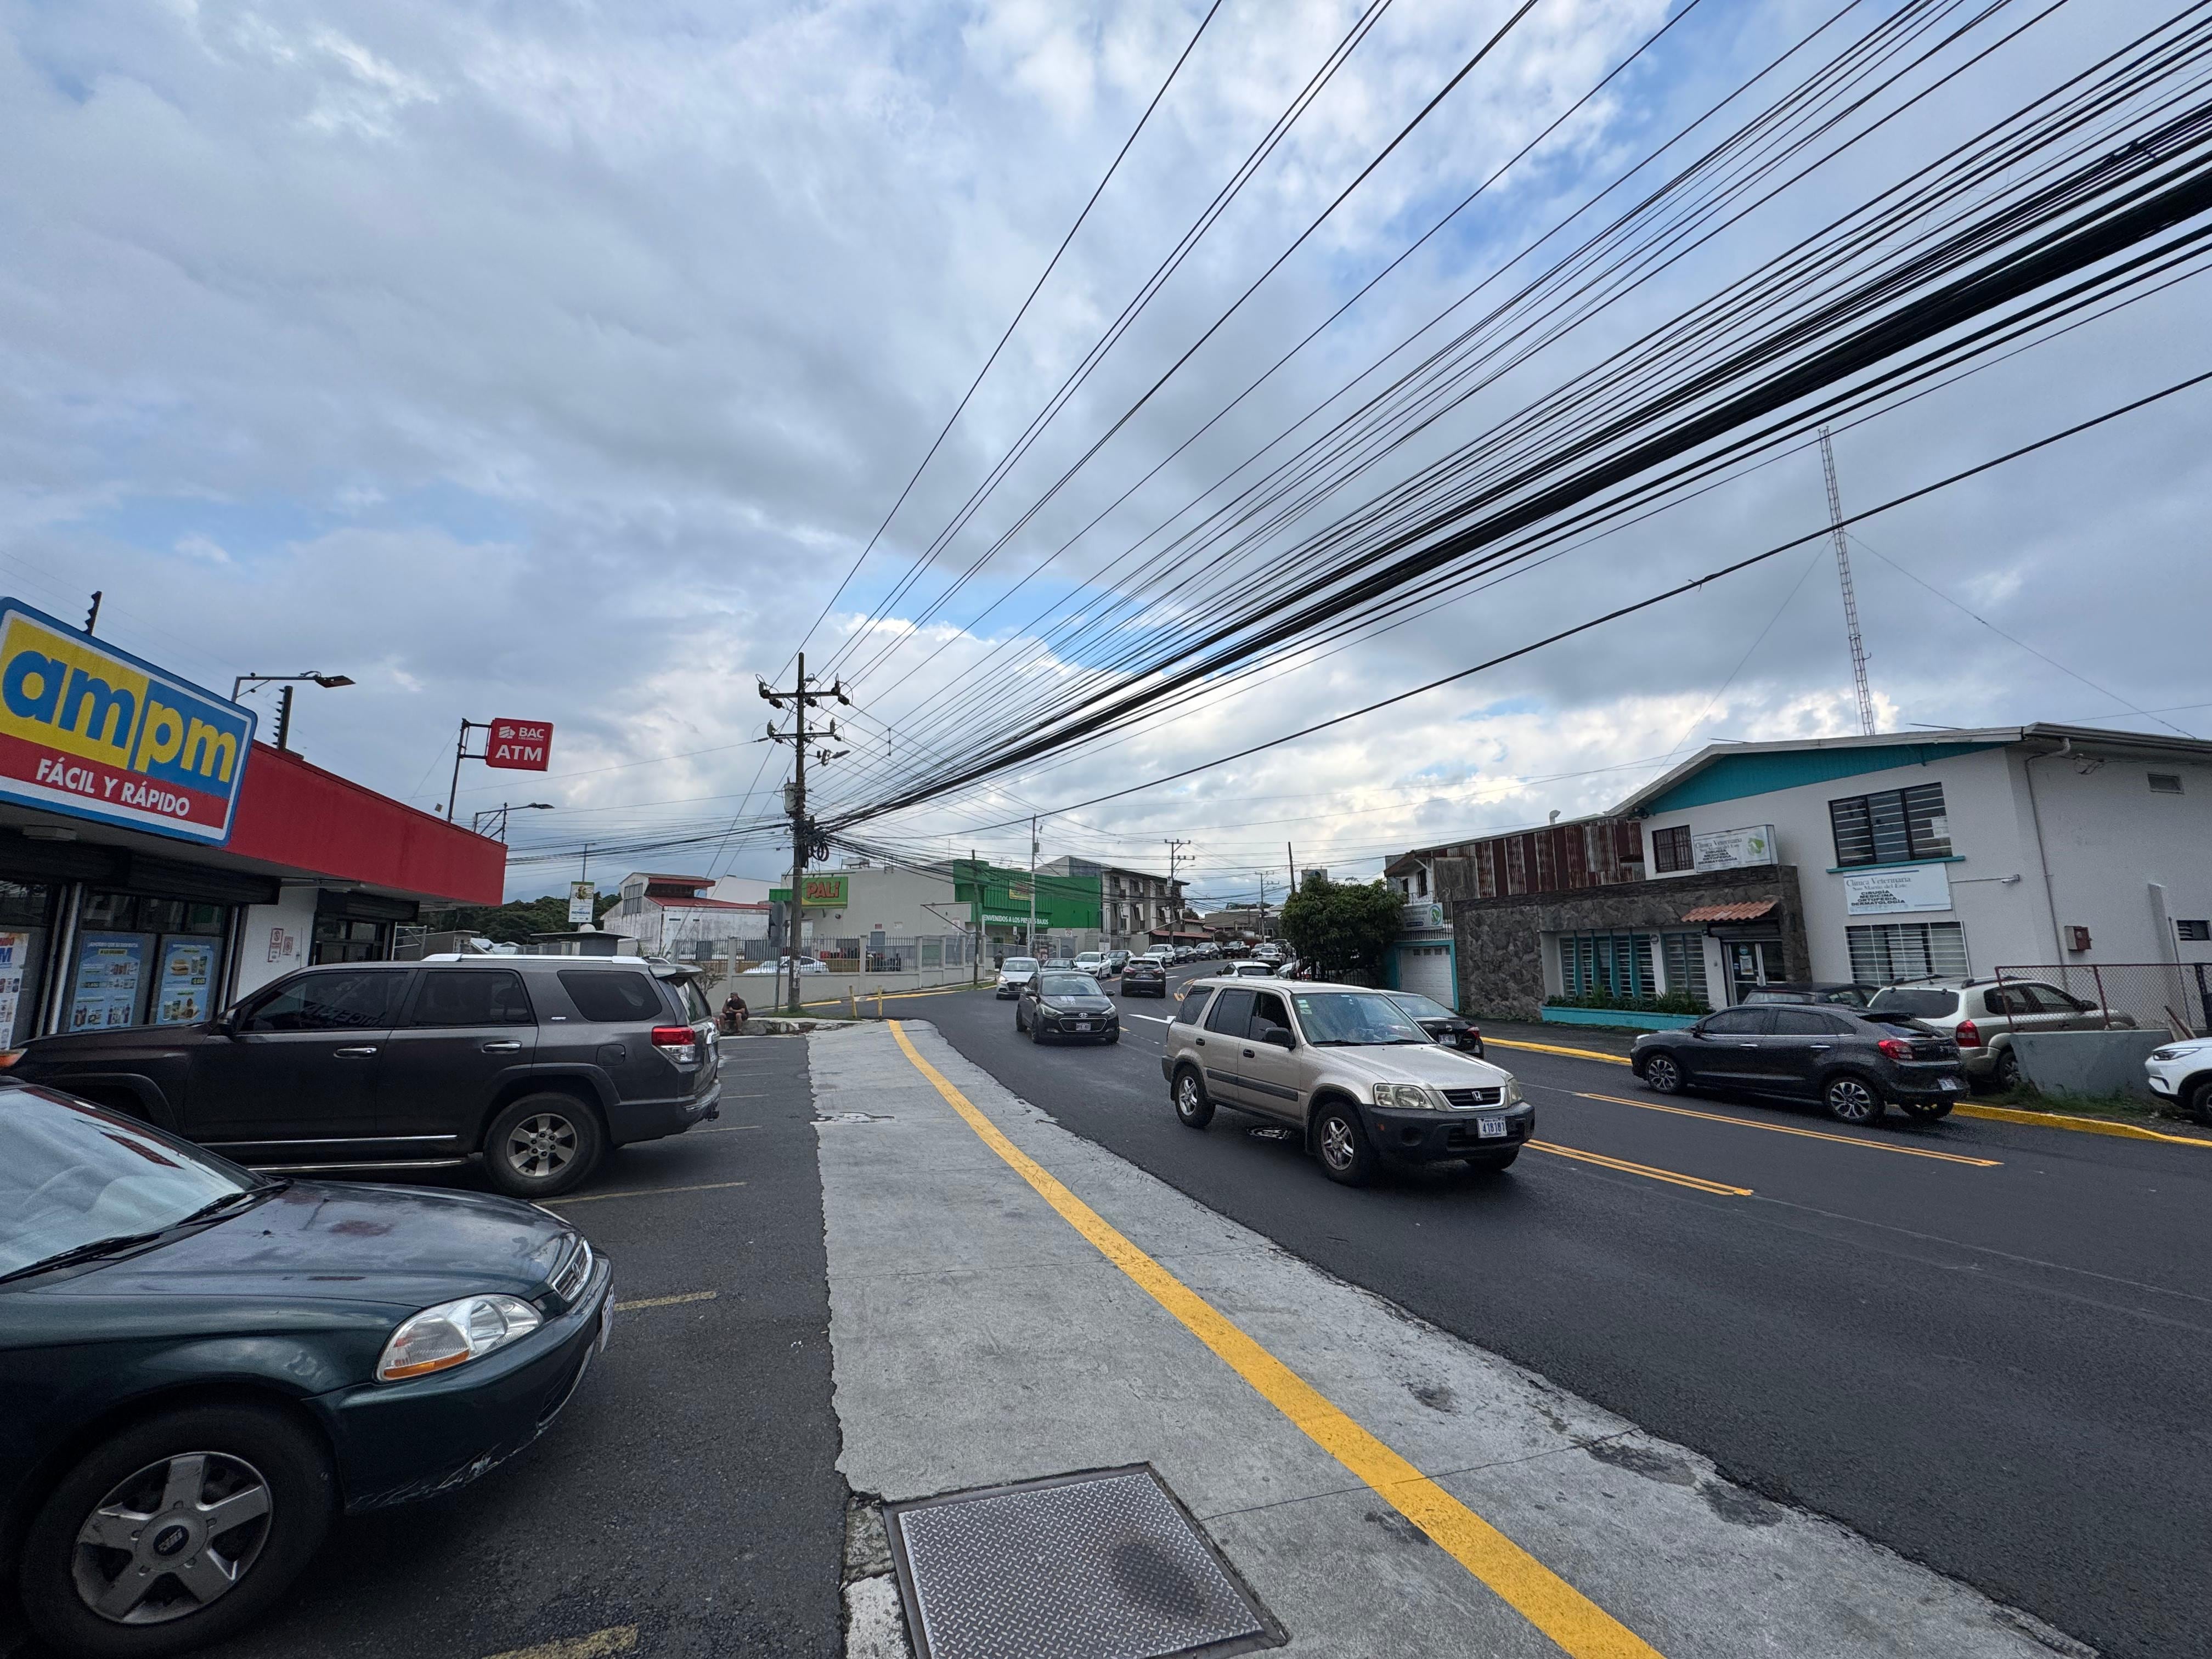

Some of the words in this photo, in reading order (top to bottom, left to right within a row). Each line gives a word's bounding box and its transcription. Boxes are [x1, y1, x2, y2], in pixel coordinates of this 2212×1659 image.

[2, 650, 237, 782] ampm
[518, 727, 545, 738] BAC
[495, 744, 542, 761] ATM
[36, 757, 95, 794] FÁCIL
[104, 778, 119, 798] Y
[121, 781, 190, 816] RÁPIDO
